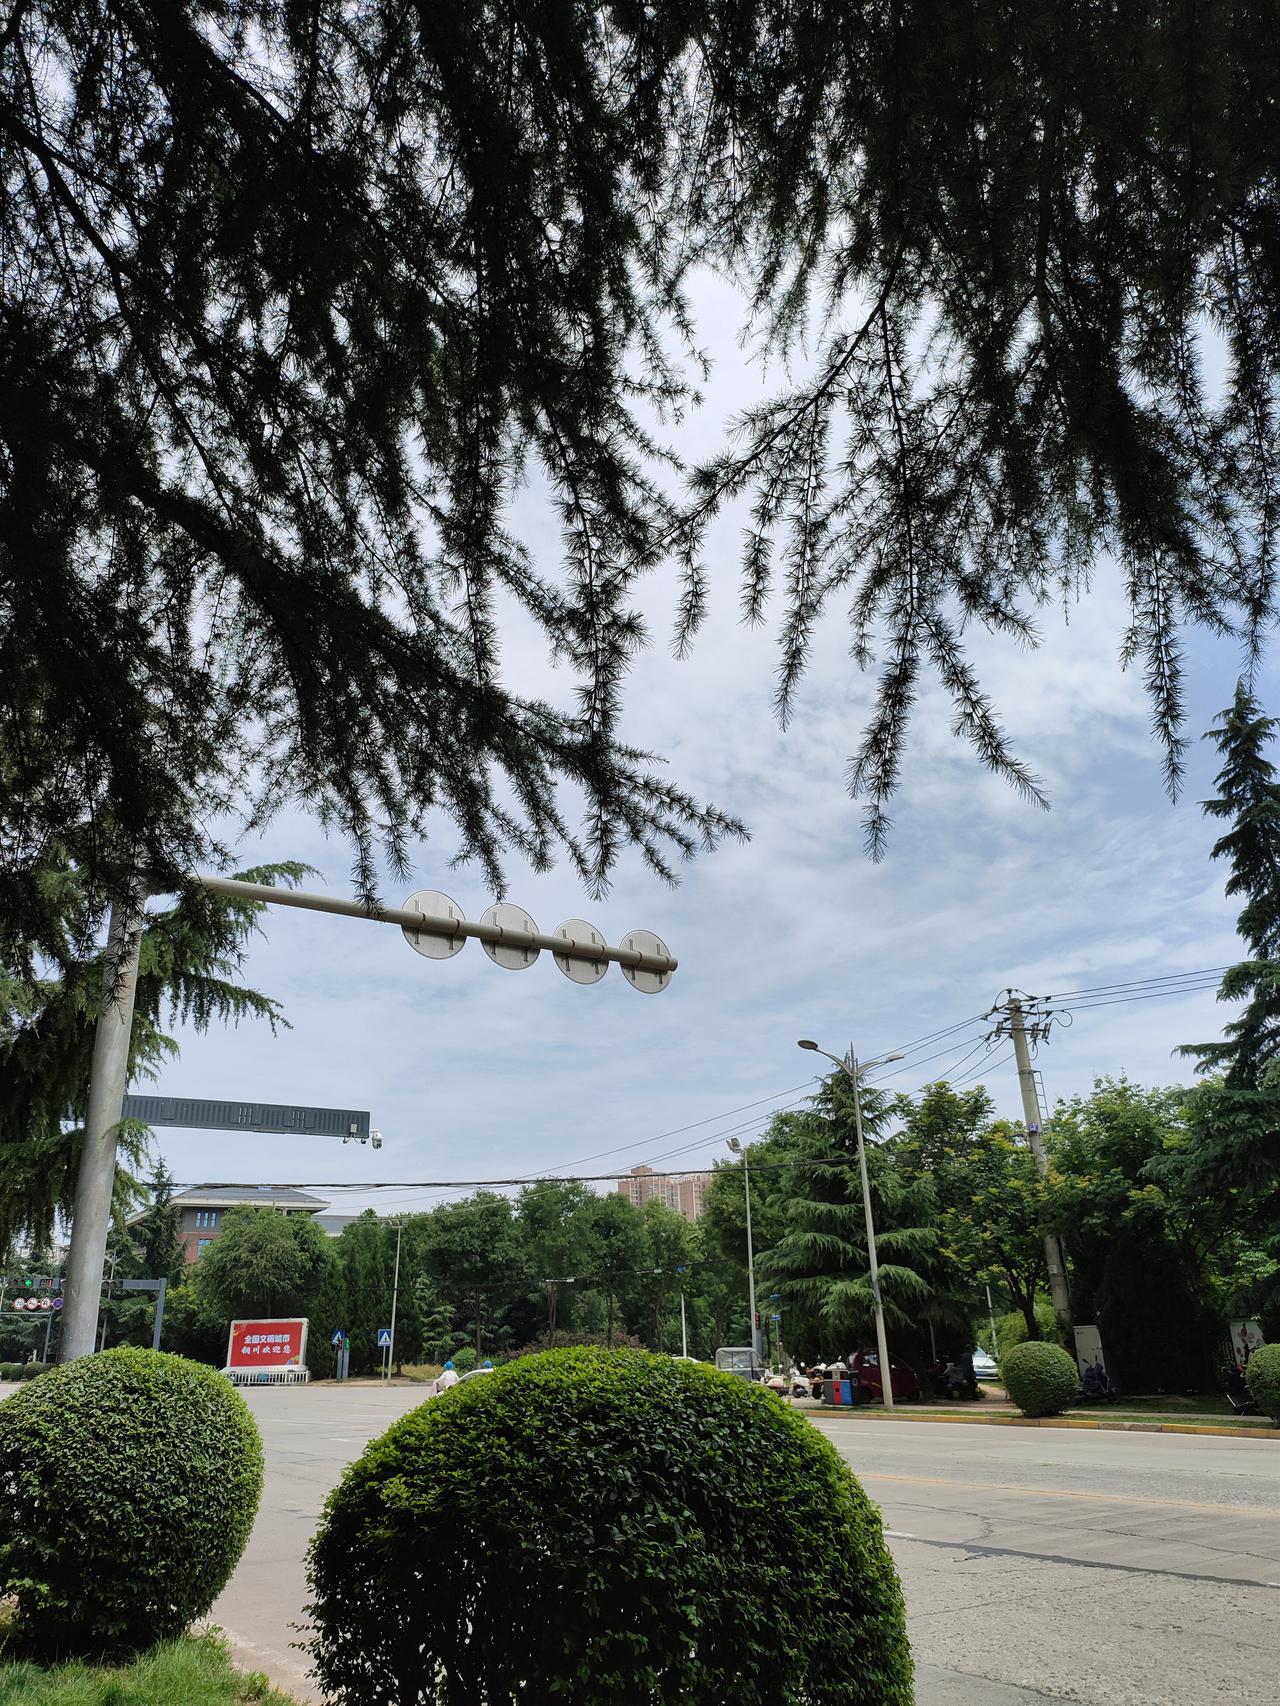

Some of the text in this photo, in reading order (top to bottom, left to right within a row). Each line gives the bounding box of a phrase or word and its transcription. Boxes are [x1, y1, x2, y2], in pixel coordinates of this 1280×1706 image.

[244, 1334, 290, 1344] 全国文明城市
